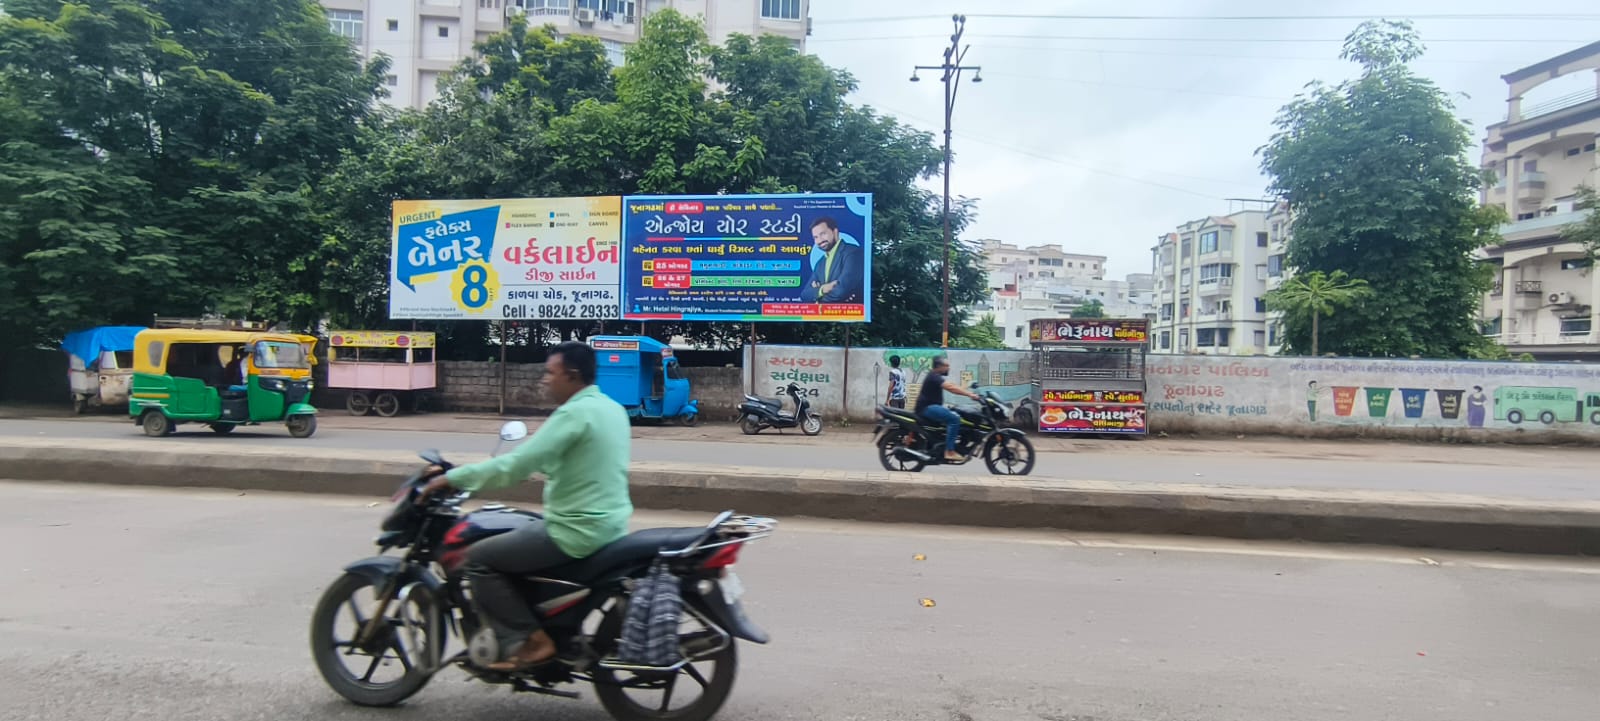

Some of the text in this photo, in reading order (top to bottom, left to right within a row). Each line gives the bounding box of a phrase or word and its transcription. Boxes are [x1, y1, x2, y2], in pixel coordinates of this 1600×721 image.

[399, 210, 437, 225] URGENT
[645, 213, 802, 236] એન્જોય યોર સ્ટડી
[407, 235, 484, 268] બેનર
[525, 267, 554, 283] ડીજી
[461, 264, 488, 308] 8
[507, 290, 539, 301] કાળવા
[502, 304, 526, 318] Cell
[538, 304, 576, 319] 98242
[580, 304, 619, 319] 29333
